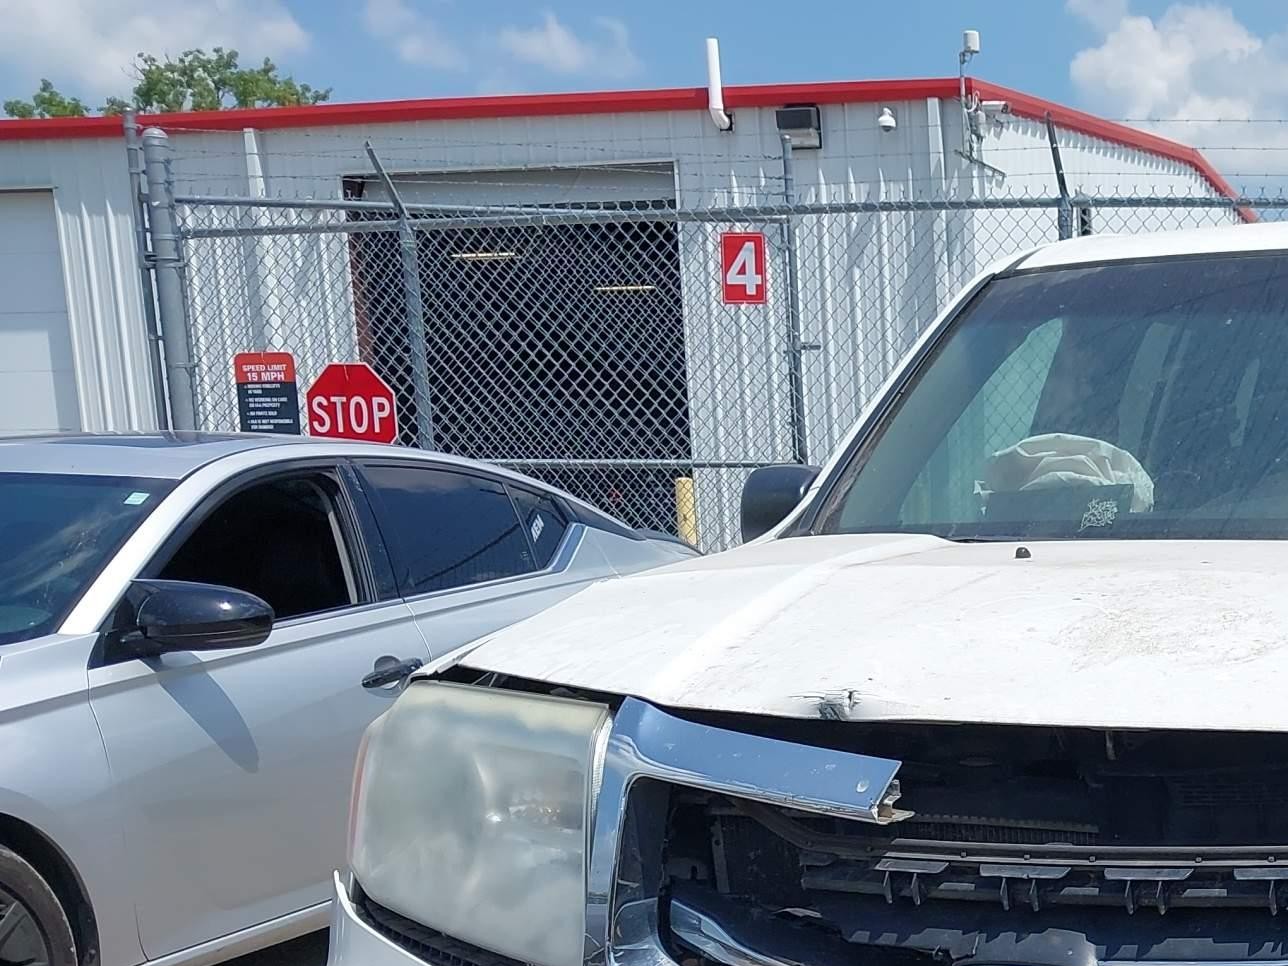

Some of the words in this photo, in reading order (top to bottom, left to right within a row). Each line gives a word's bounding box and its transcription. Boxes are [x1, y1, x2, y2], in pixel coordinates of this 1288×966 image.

[726, 241, 762, 296] 4
[242, 364, 266, 372] SPEED
[247, 372, 258, 381] 15
[261, 371, 285, 381] MPH
[312, 395, 391, 434] STOP
